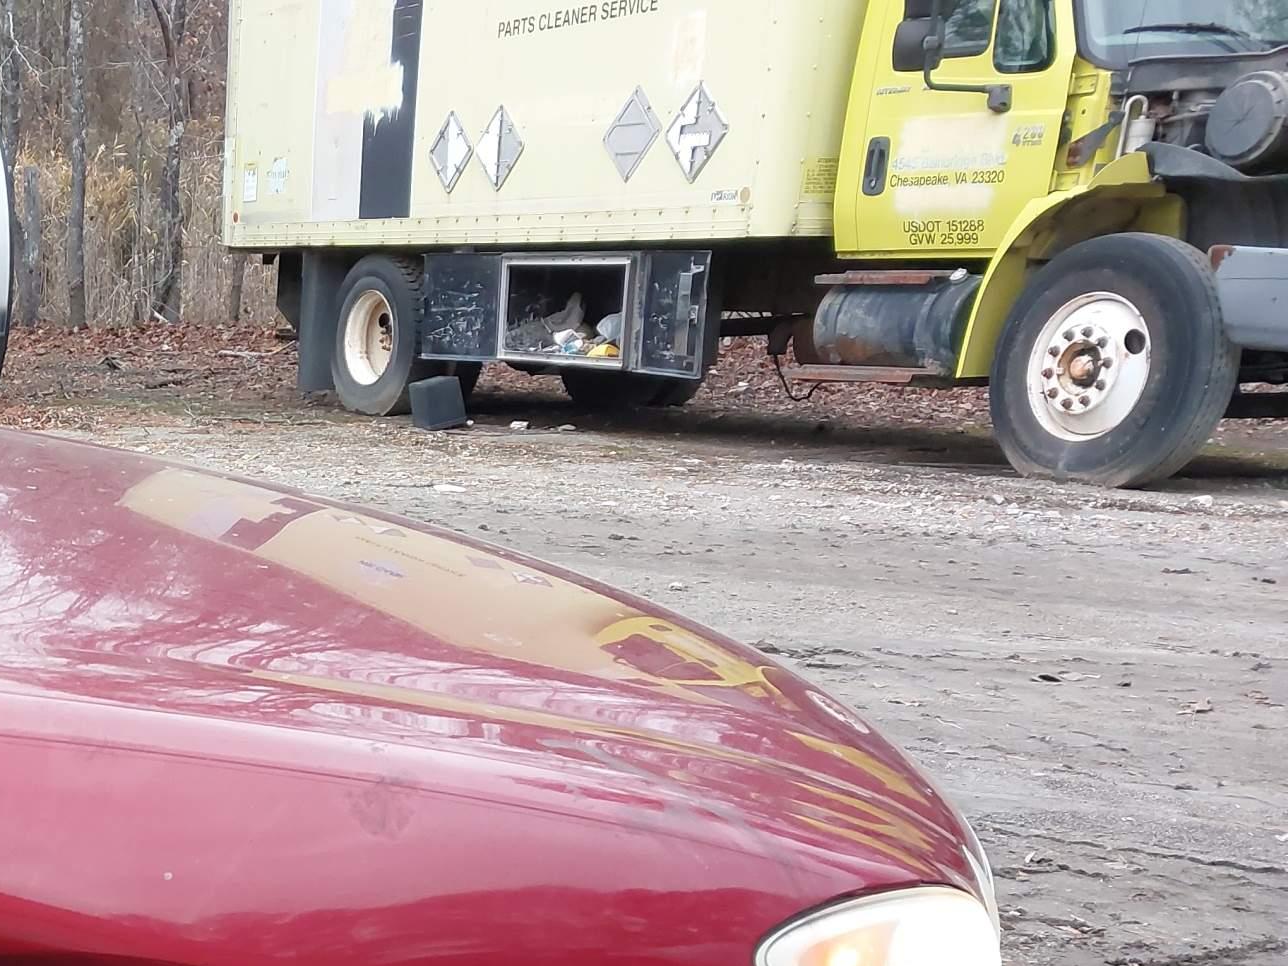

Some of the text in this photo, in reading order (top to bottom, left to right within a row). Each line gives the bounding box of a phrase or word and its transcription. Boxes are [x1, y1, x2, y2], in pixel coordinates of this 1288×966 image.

[498, 0, 659, 38] PARTS CLEANER SERVICE
[955, 171, 968, 185] VA
[971, 169, 1005, 184] 23320
[903, 219, 985, 233] USDOT 151288
[909, 232, 979, 246] GVW 25,999
